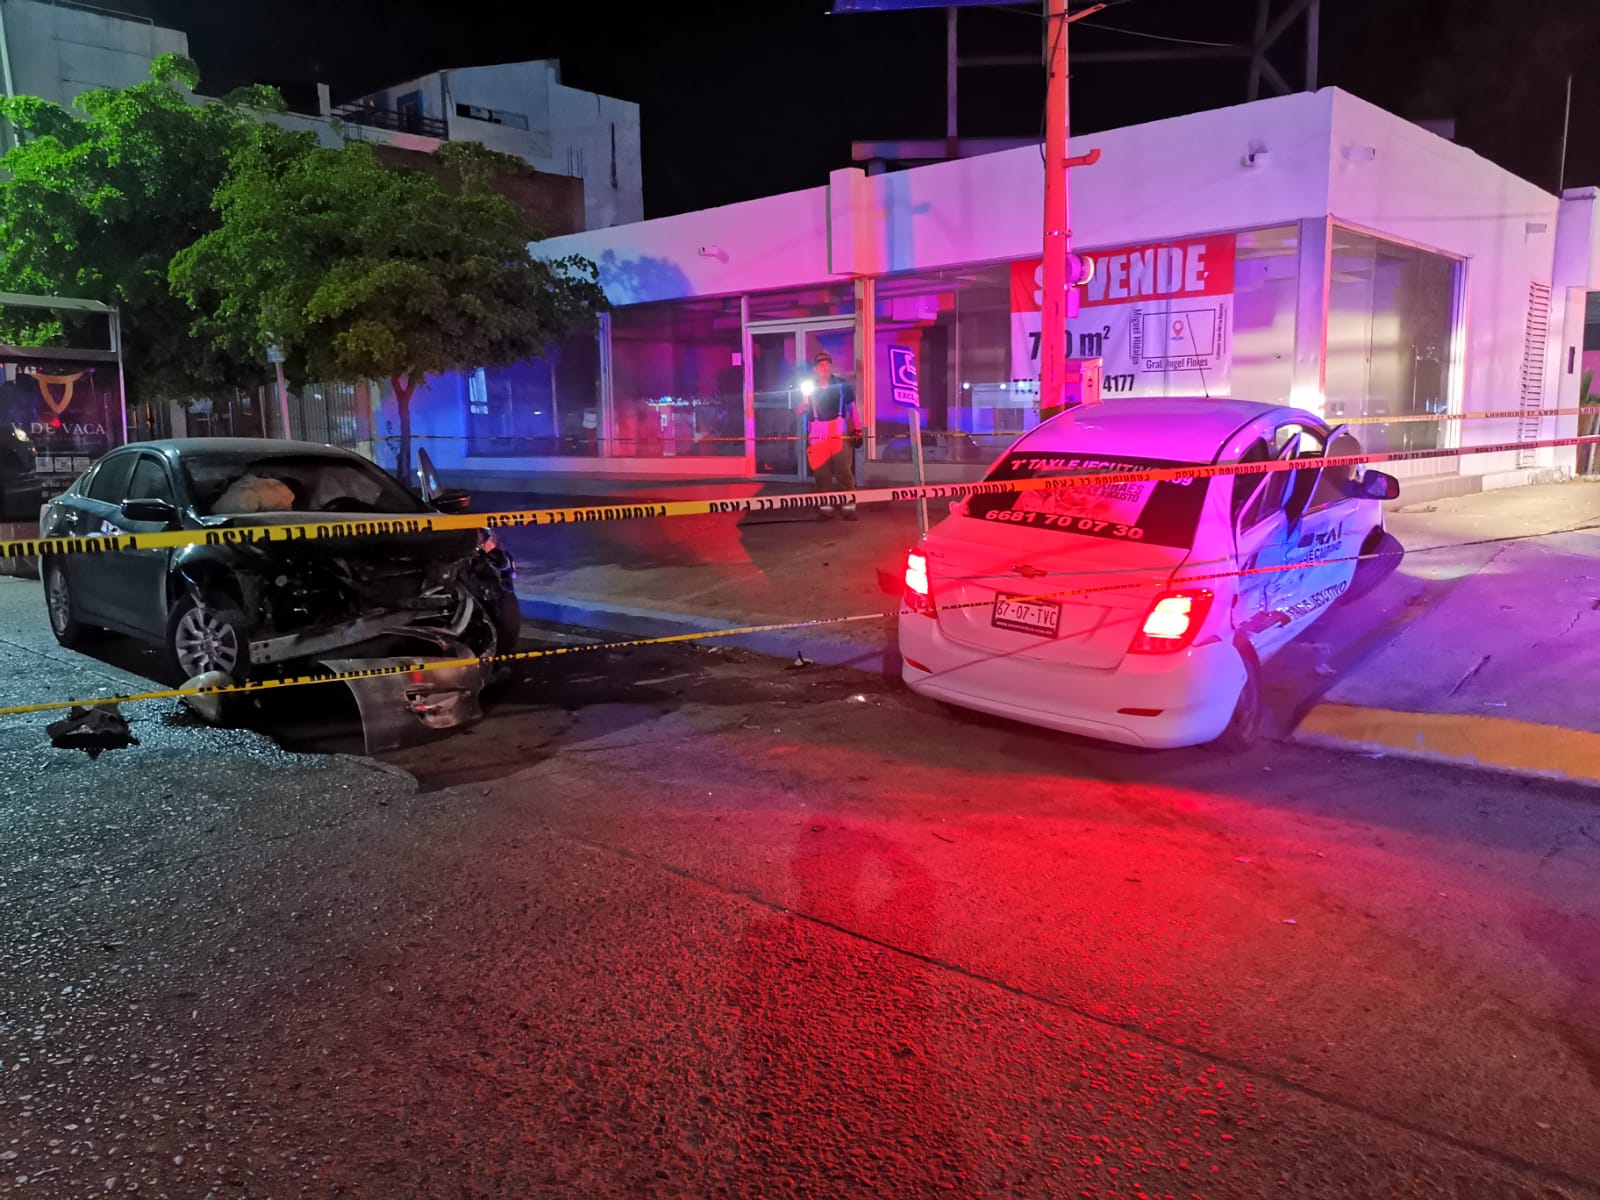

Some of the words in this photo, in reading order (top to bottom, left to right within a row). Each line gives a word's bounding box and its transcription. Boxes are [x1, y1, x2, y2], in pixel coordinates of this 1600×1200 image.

[1087, 244, 1206, 301] VENDE
[1103, 374, 1135, 393] 4177
[62, 423, 106, 435] VACA
[985, 509, 1038, 523] 6681
[1044, 514, 1072, 528] 70
[1078, 518, 1108, 532] 07
[1113, 524, 1144, 540] 30
